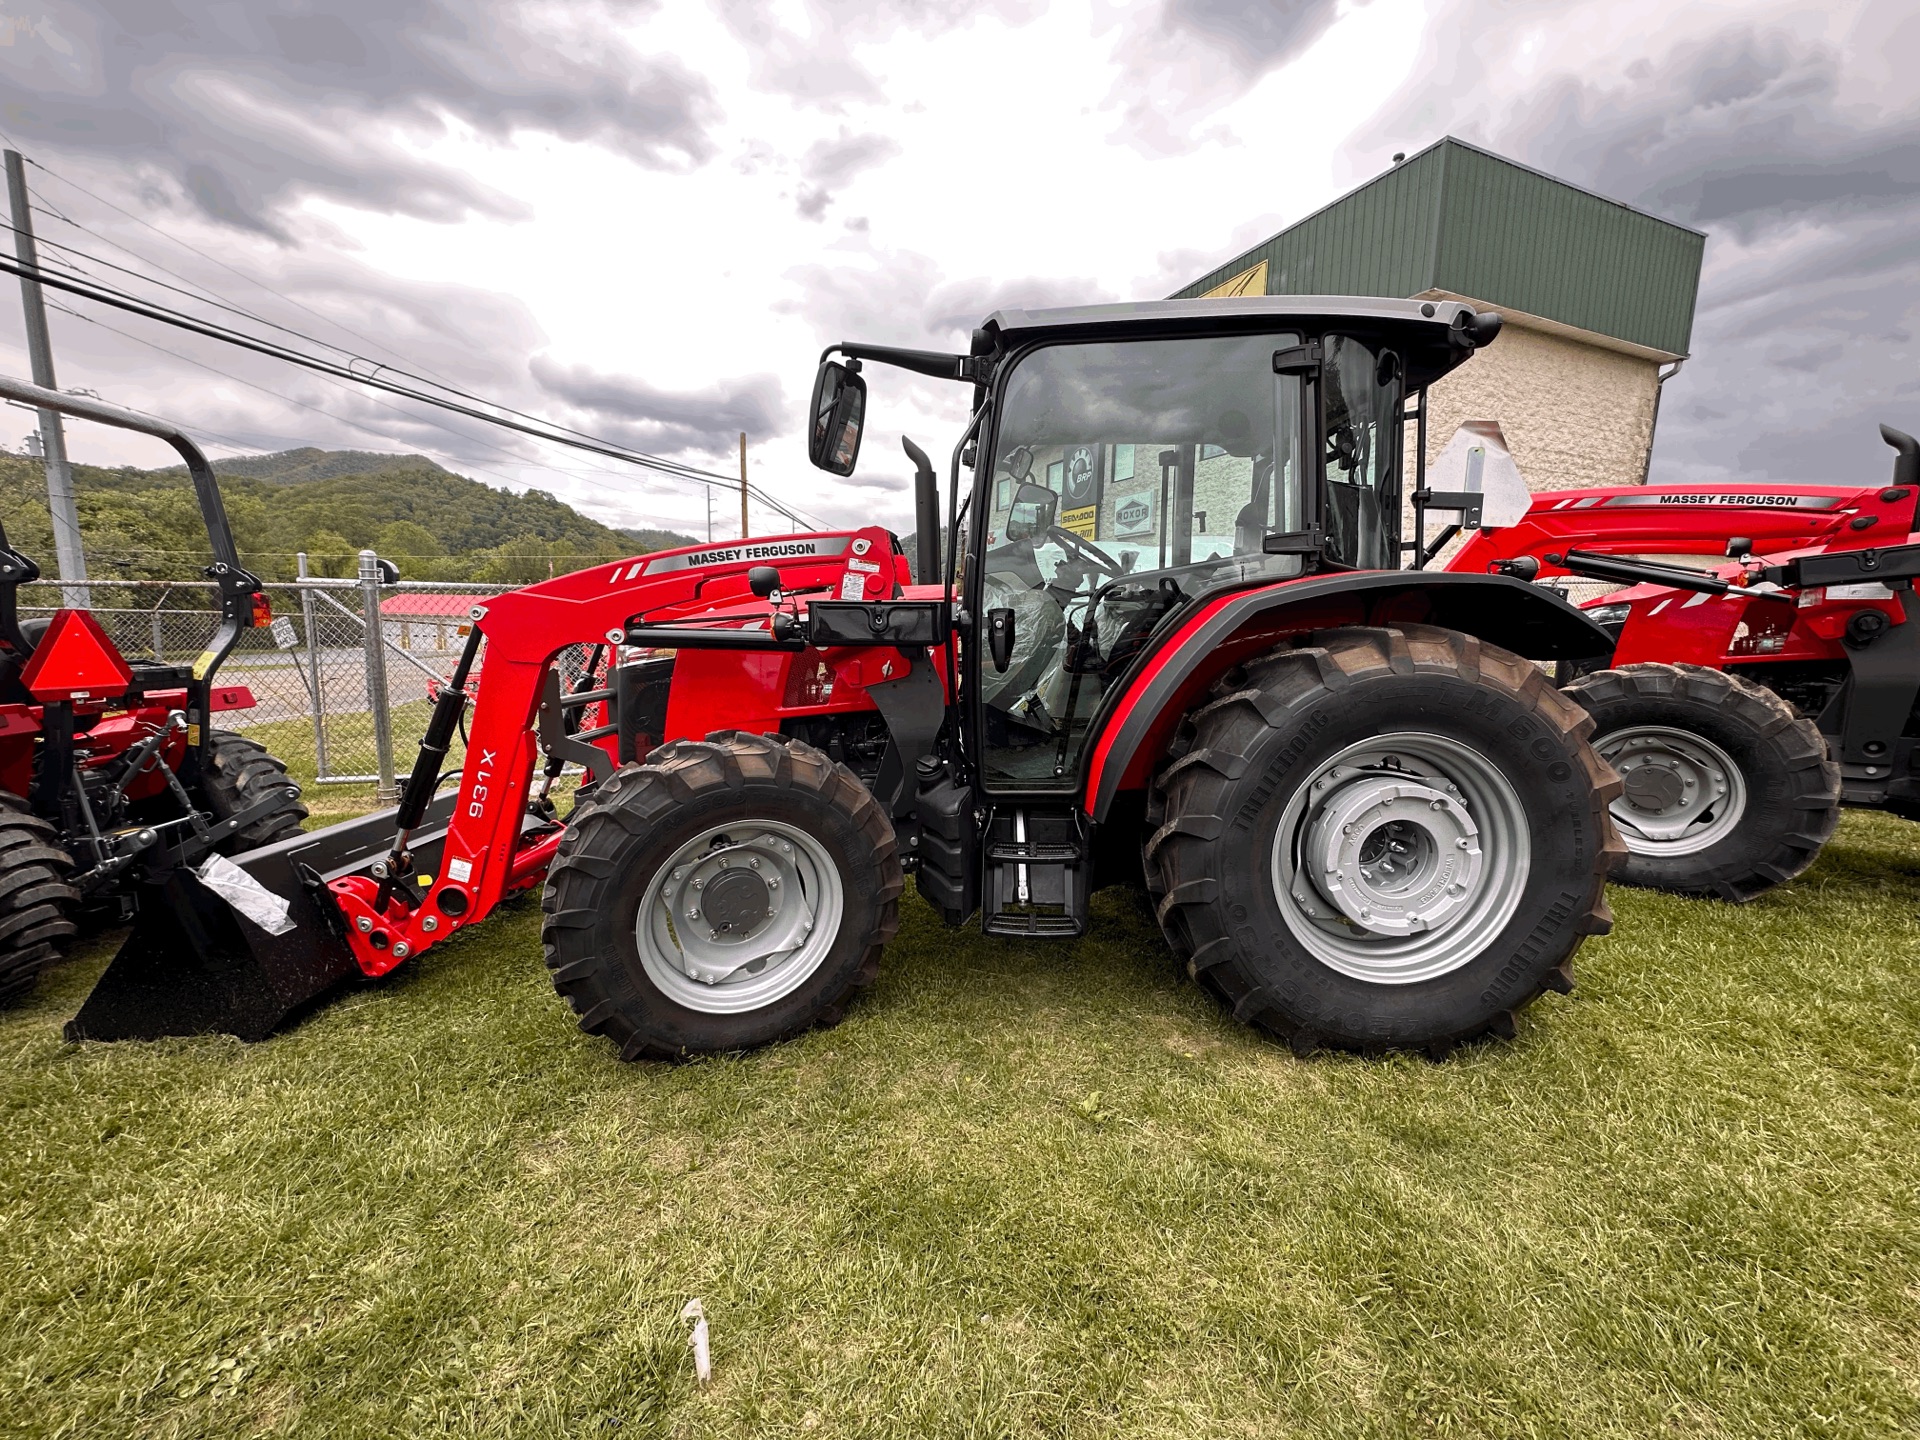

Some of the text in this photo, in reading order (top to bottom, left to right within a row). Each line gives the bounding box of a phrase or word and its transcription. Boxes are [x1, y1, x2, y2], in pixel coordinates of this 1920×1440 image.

[1077, 471, 1092, 483] BRP
[1660, 495, 1798, 506] MASSEY FERGUSON
[1117, 508, 1148, 521] ROXOR
[688, 543, 816, 566] MASSEY FERGUSON
[1438, 681, 1573, 784] TM 600
[469, 748, 496, 818] 931X
[1228, 709, 1329, 834] TRELLEBORG
[1348, 823, 1365, 847] AGCO
[1479, 891, 1583, 1011] TRELLEBORG
